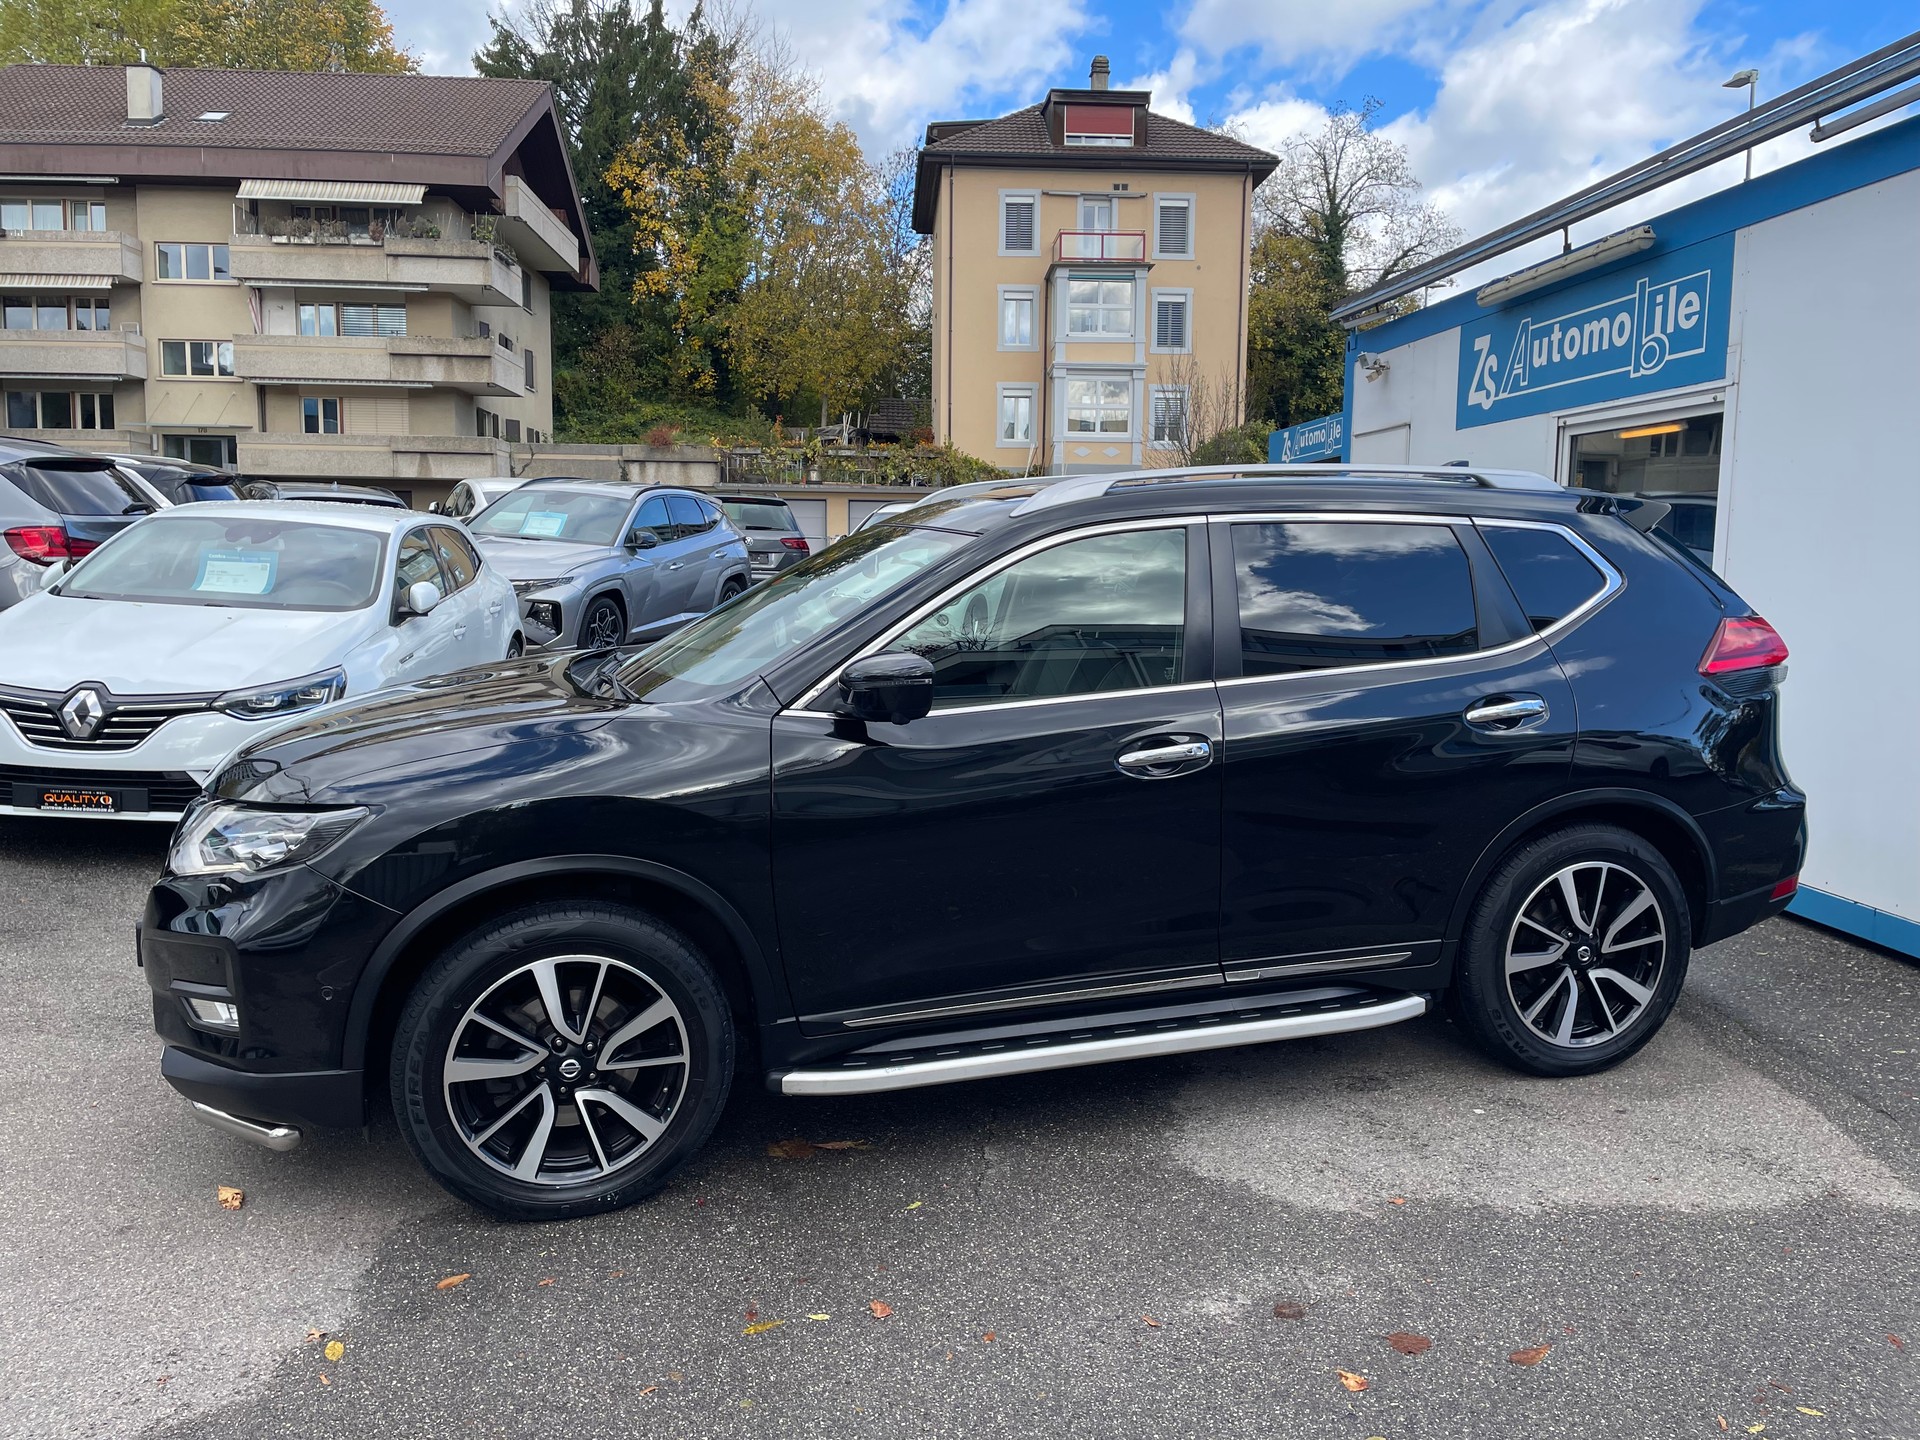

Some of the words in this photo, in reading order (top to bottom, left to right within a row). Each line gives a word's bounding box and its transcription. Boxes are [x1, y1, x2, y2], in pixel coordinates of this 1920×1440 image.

[1467, 333, 1498, 410] Zs
[1499, 276, 1702, 398] Automobile
[1292, 417, 1342, 457] Automobile
[43, 793, 100, 803] QUALITY
